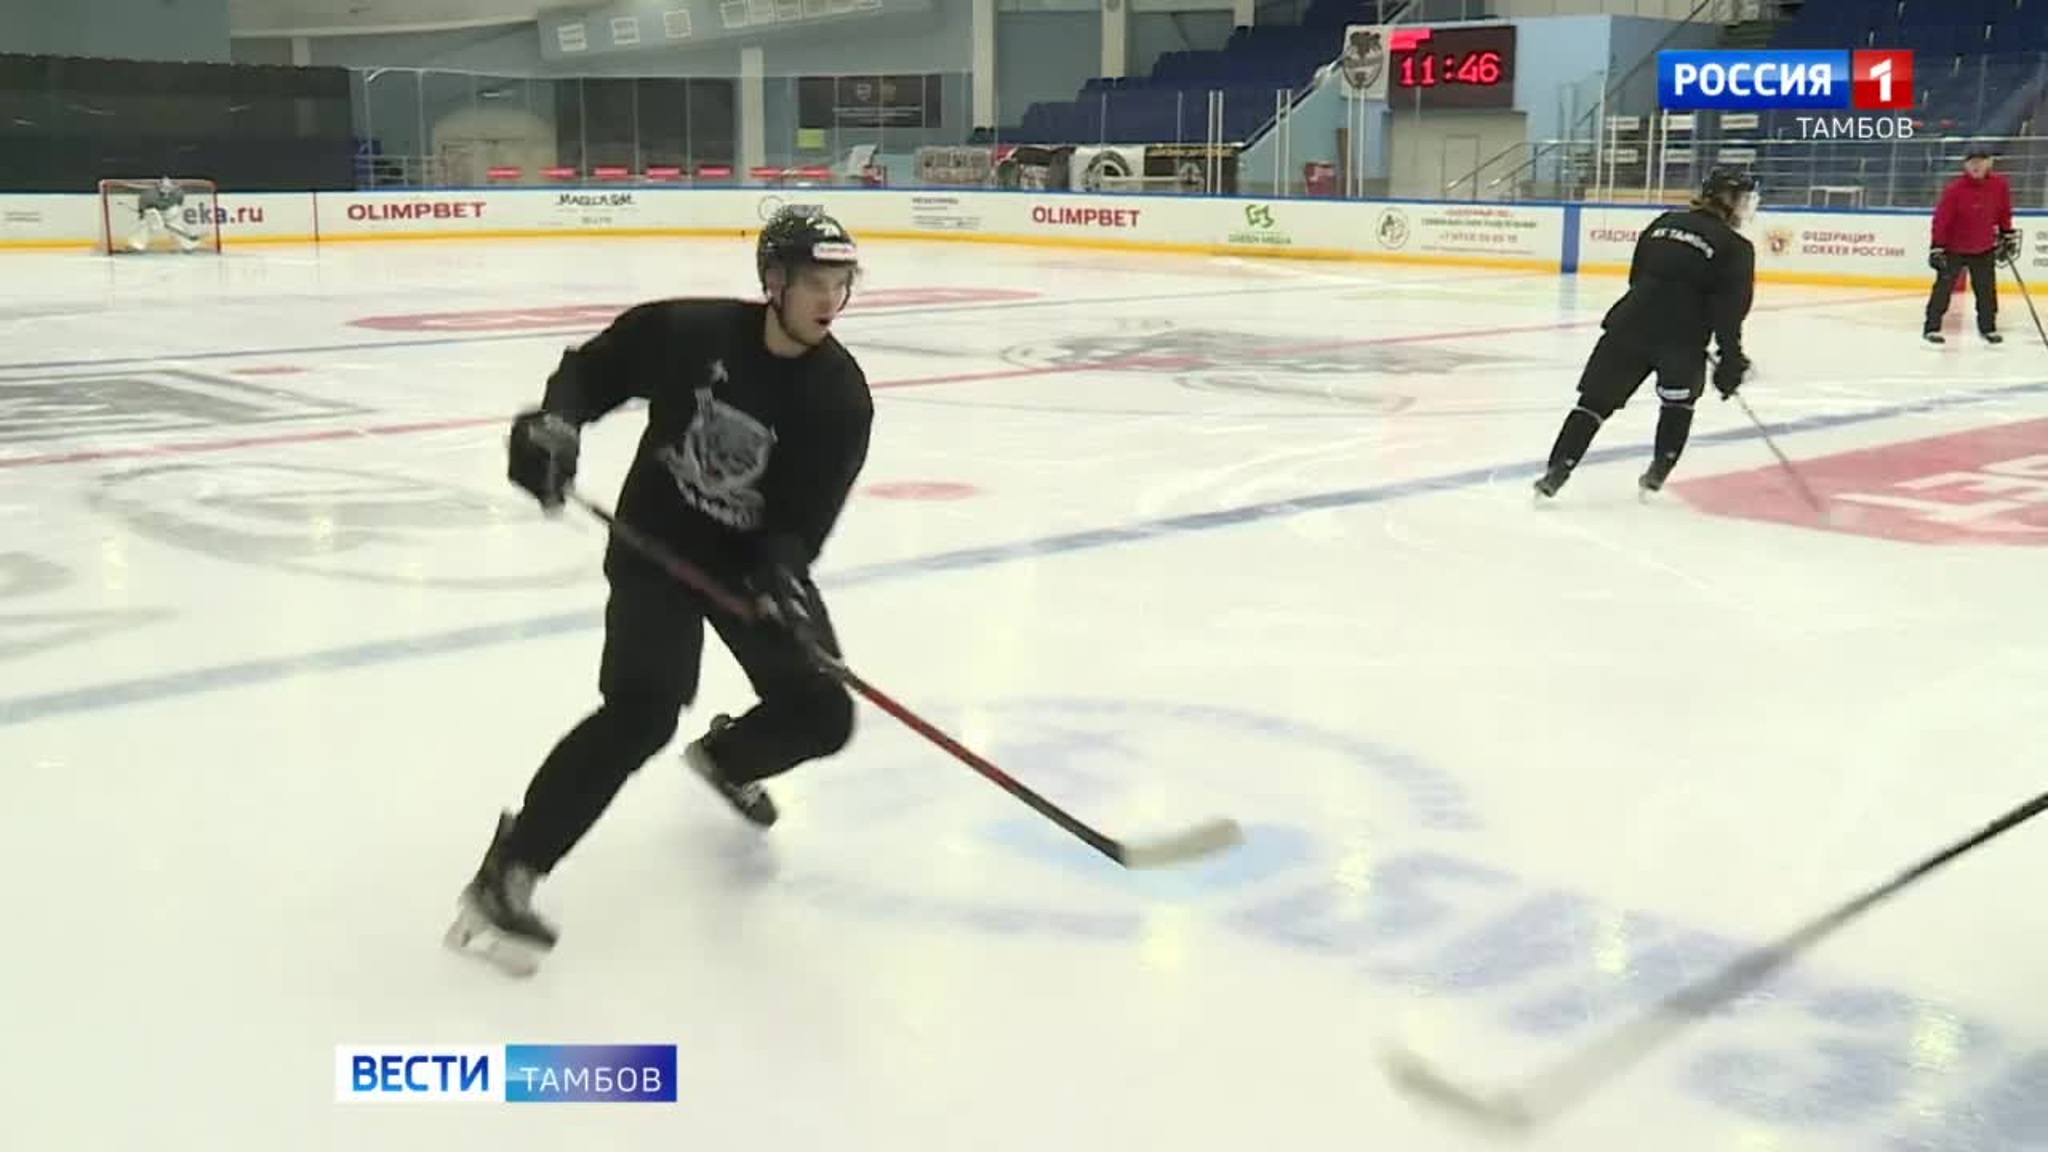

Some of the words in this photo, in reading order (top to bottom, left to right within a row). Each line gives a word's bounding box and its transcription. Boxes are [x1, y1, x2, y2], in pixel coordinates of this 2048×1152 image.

[1401, 52, 1501, 86] 11:46
[347, 202, 487, 220] OLIMPBET
[1032, 205, 1140, 228] OLIMPBET
[1802, 230, 1875, 243] ФЕДЕРАЦИЯ
